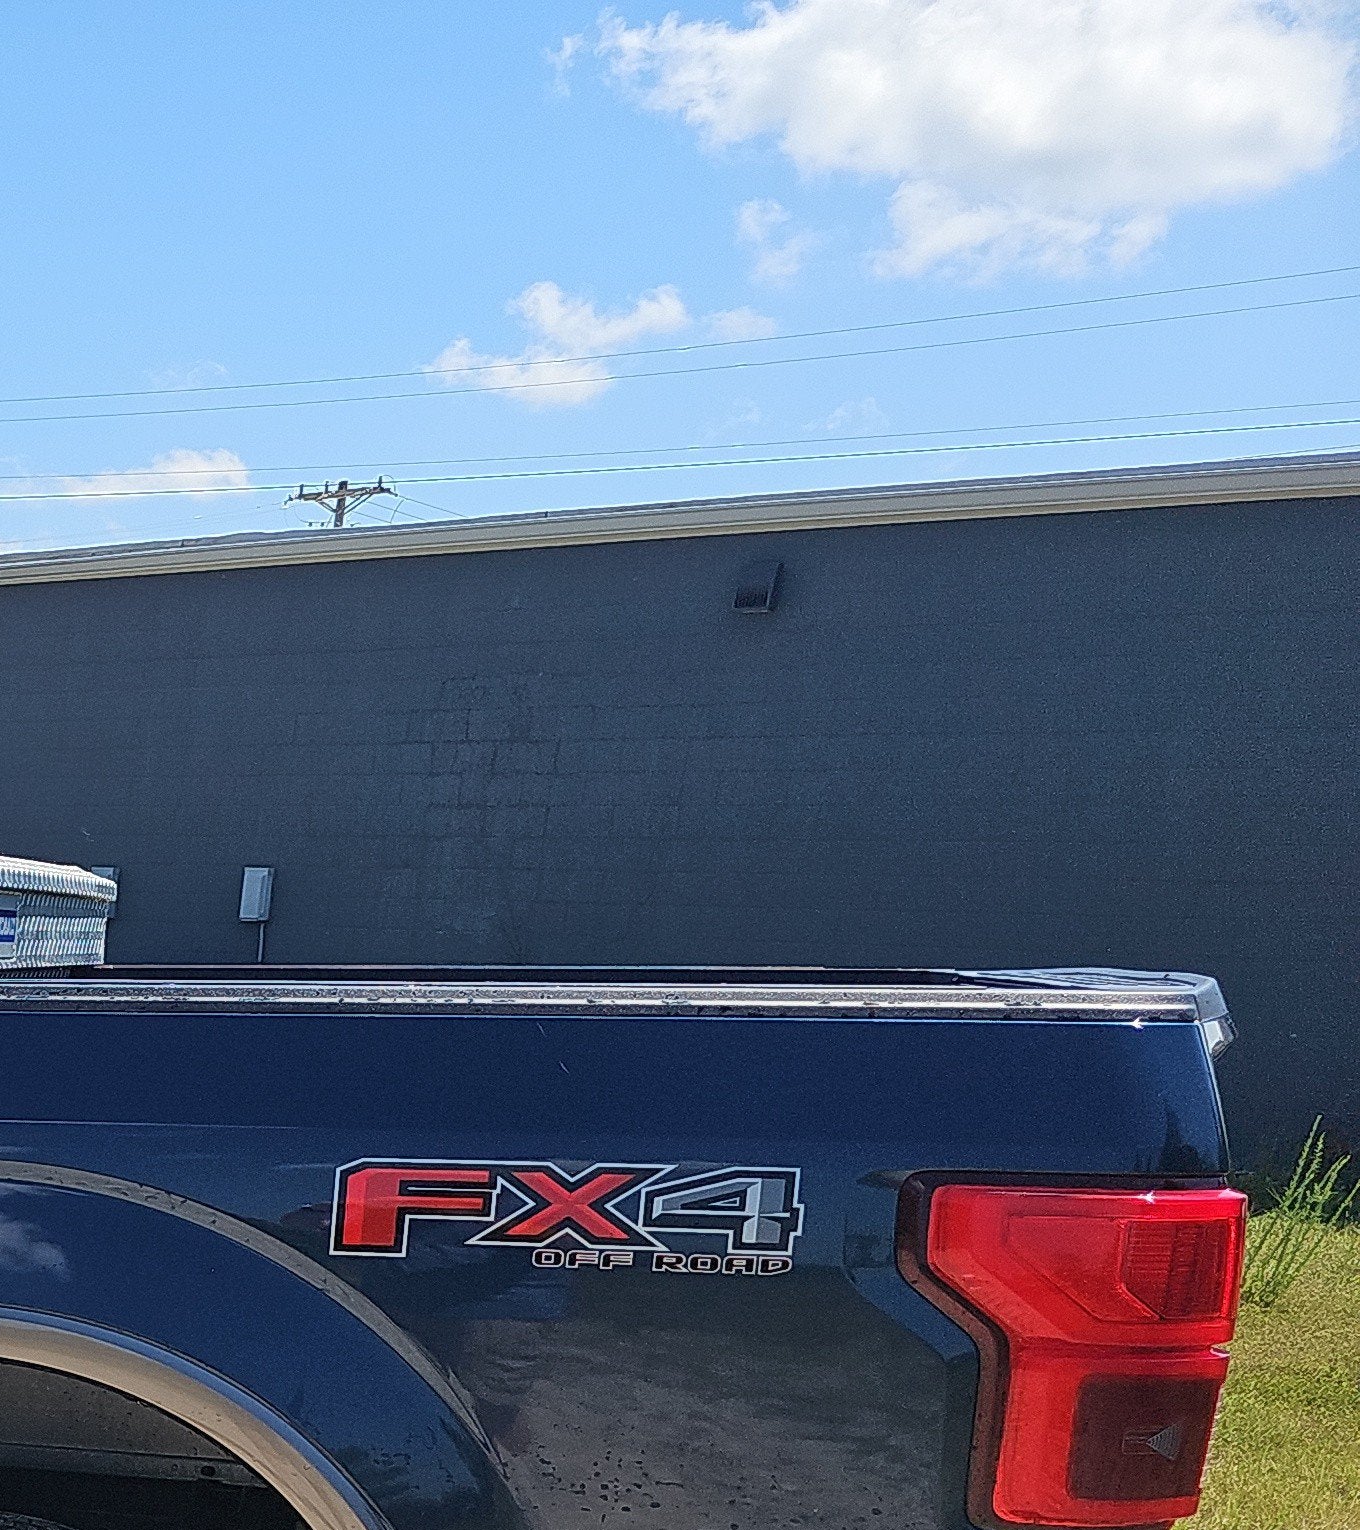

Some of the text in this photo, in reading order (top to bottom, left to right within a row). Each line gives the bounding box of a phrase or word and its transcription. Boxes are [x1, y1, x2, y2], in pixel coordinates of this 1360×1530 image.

[329, 1158, 805, 1258] FX4
[532, 1249, 794, 1276] OFF ROAD
